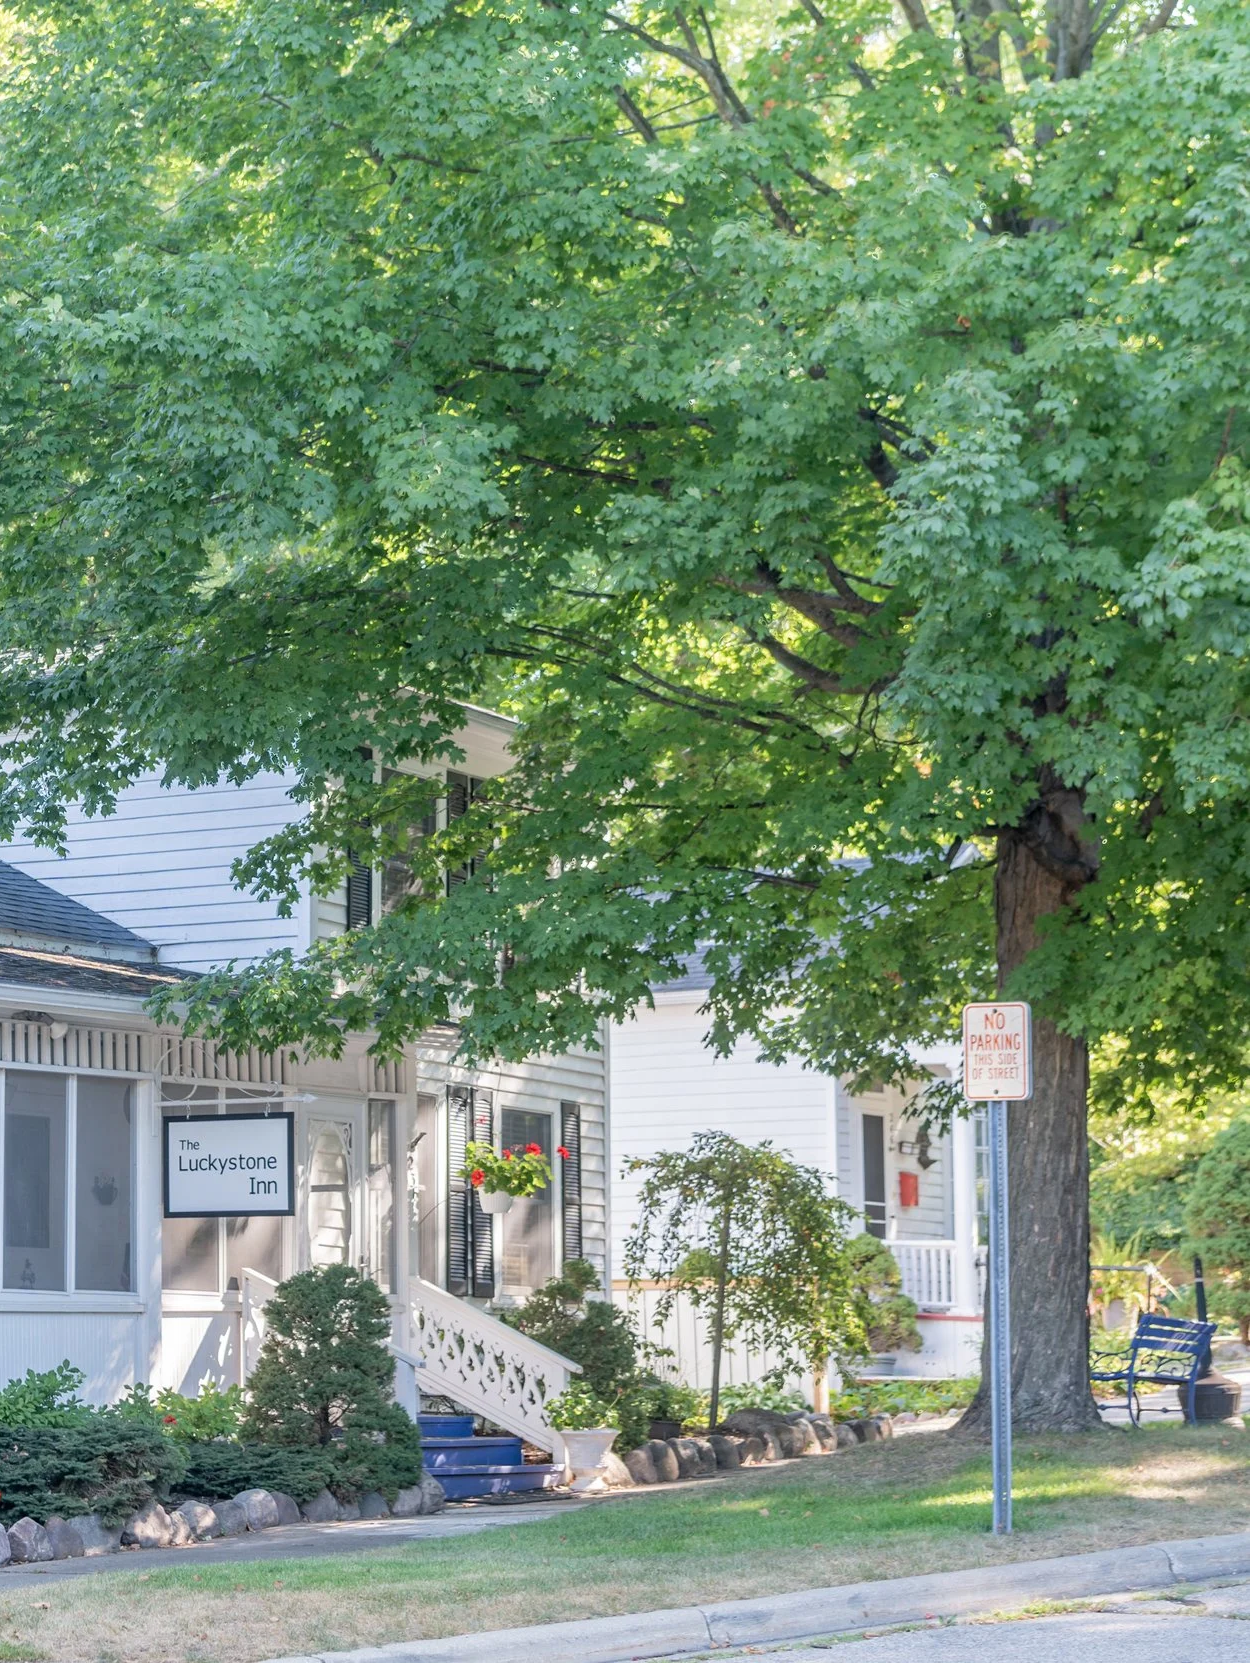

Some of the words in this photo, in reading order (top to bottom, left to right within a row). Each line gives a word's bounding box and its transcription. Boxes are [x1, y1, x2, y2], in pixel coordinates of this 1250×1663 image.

[984, 1012, 1005, 1030] NO
[970, 1033, 1021, 1050] PARKING
[974, 1054, 993, 1065] THIS
[998, 1053, 1017, 1065] SIDE
[972, 1068, 983, 1080] OF
[988, 1067, 1019, 1080] STREET
[179, 1139, 200, 1150] The
[179, 1154, 278, 1175] Luckystone
[249, 1177, 278, 1195] Inn
